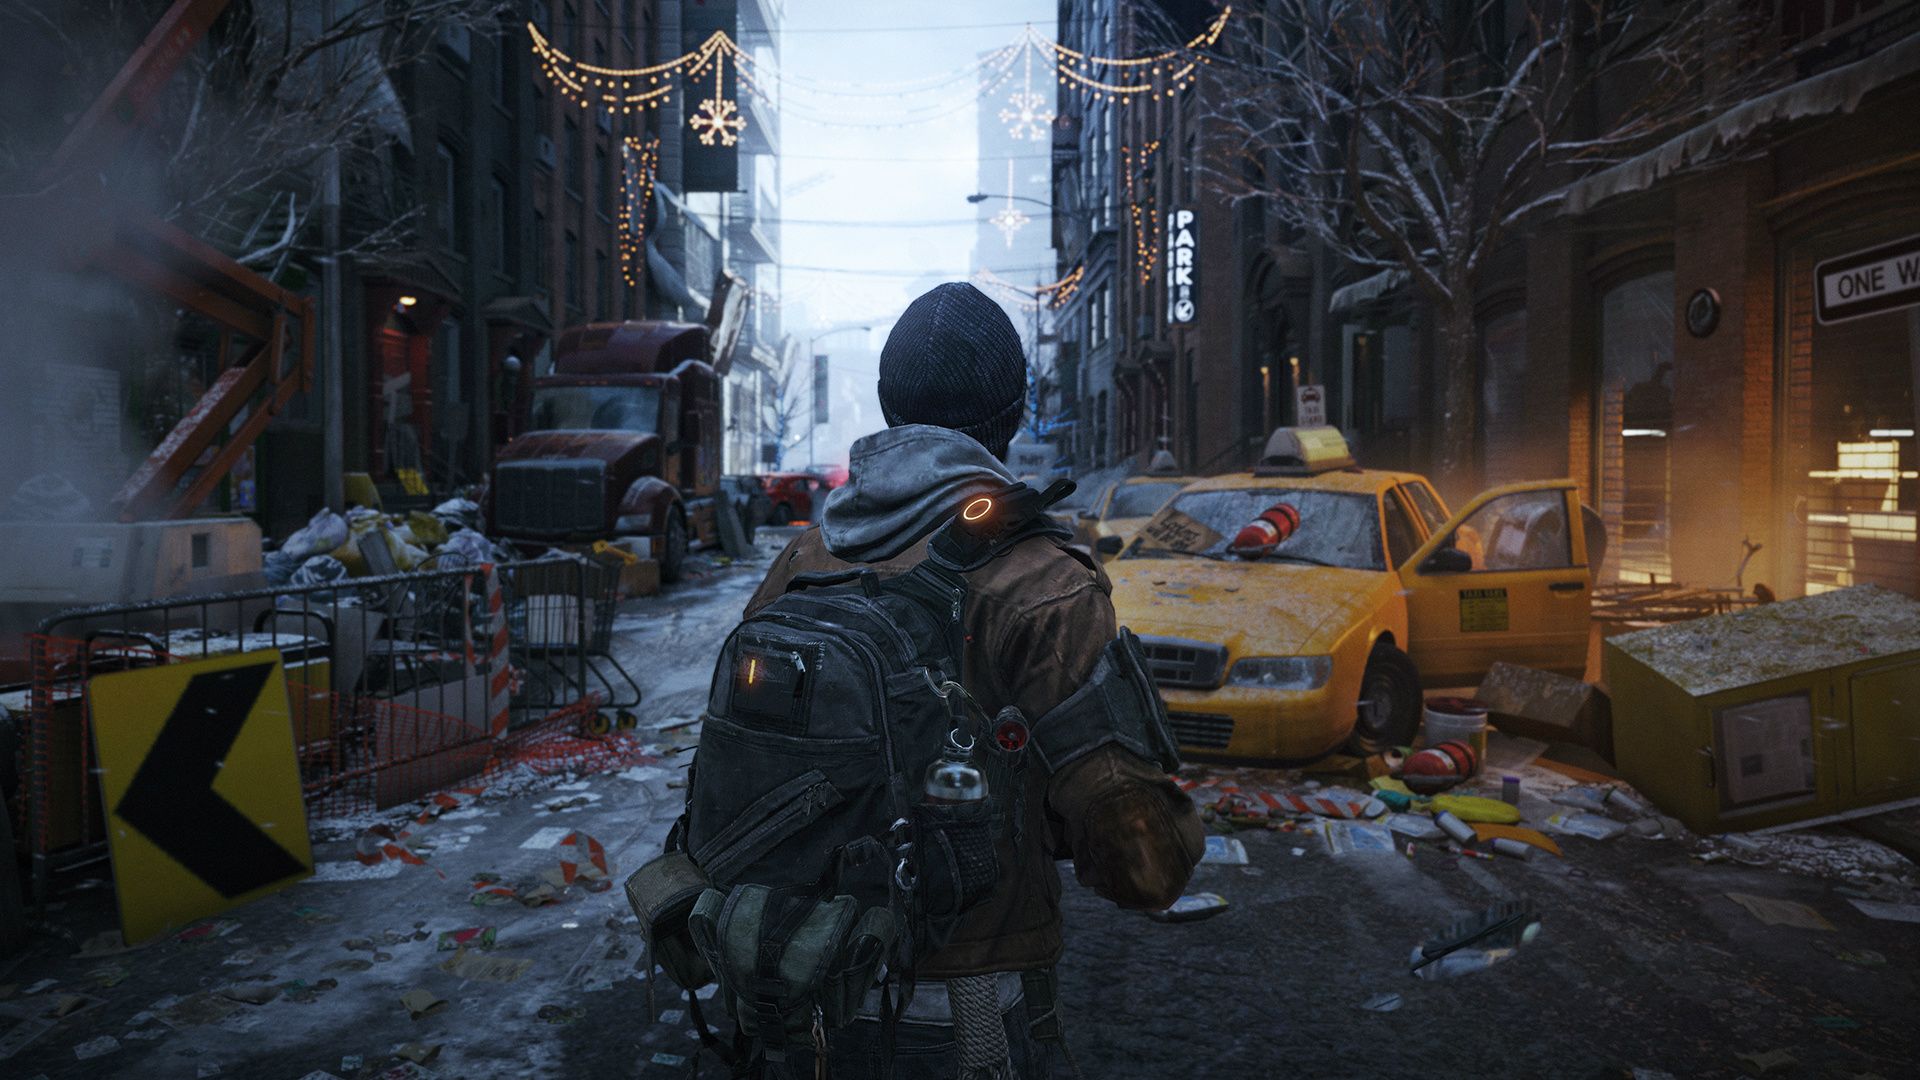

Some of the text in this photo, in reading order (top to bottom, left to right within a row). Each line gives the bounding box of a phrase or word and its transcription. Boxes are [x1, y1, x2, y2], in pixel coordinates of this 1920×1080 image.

[1175, 210, 1195, 286] PARK
[1838, 256, 1920, 299] ONE W
